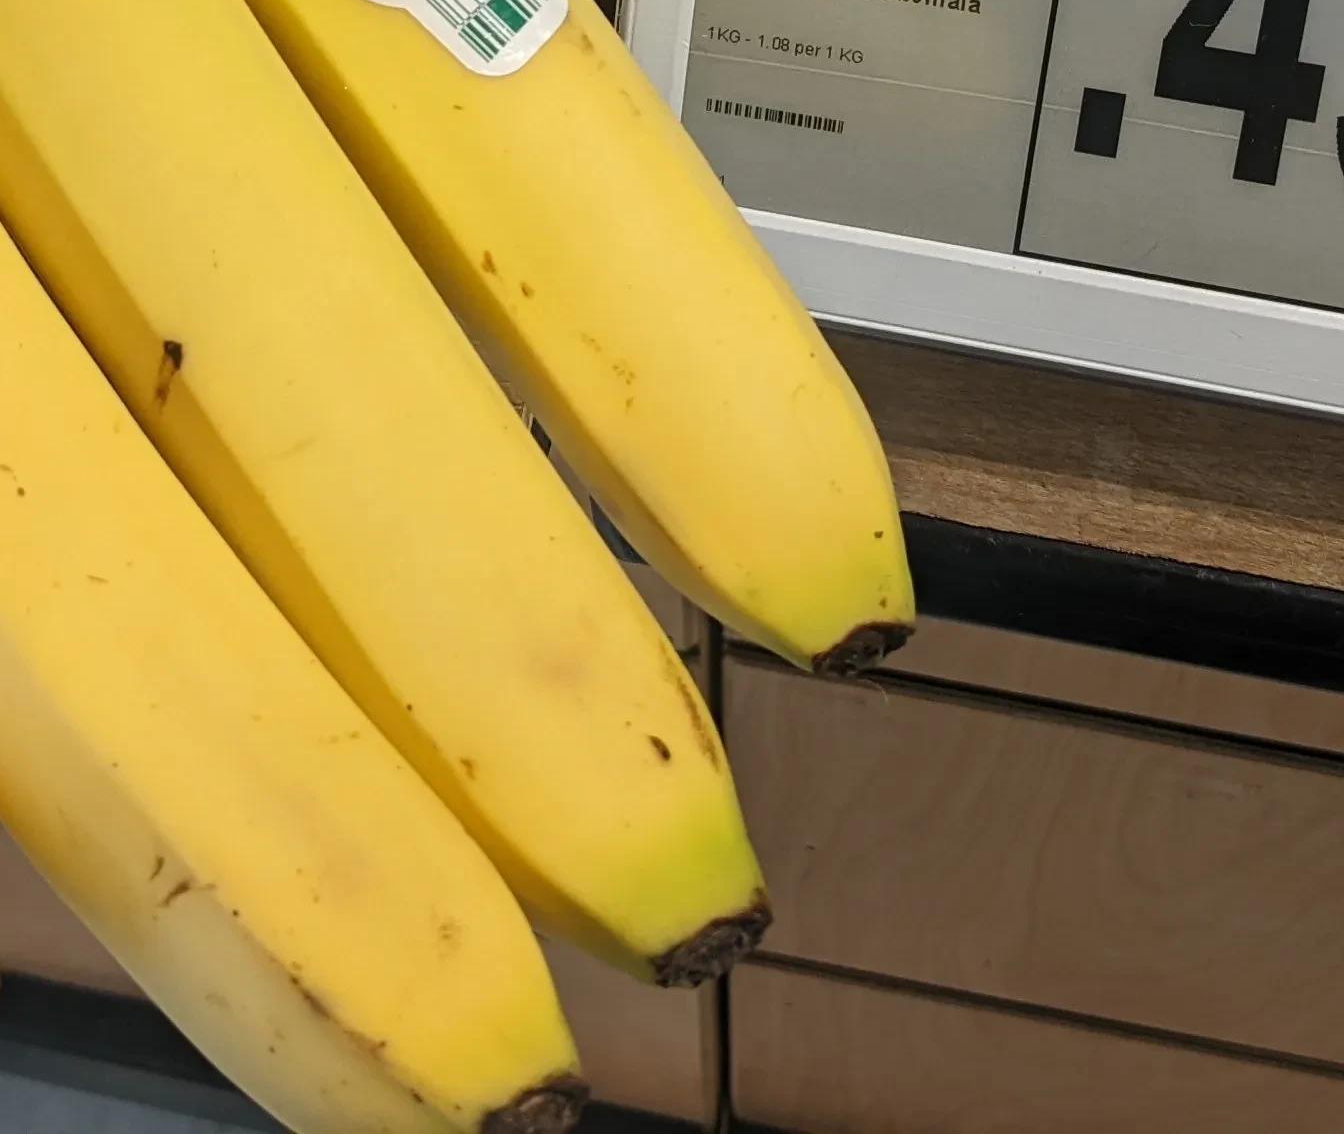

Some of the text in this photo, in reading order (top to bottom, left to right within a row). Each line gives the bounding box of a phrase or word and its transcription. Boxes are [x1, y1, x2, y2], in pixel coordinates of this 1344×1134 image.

[758, 34, 790, 53] 1.08
[794, 42, 821, 56] per
[840, 47, 864, 64] KG
